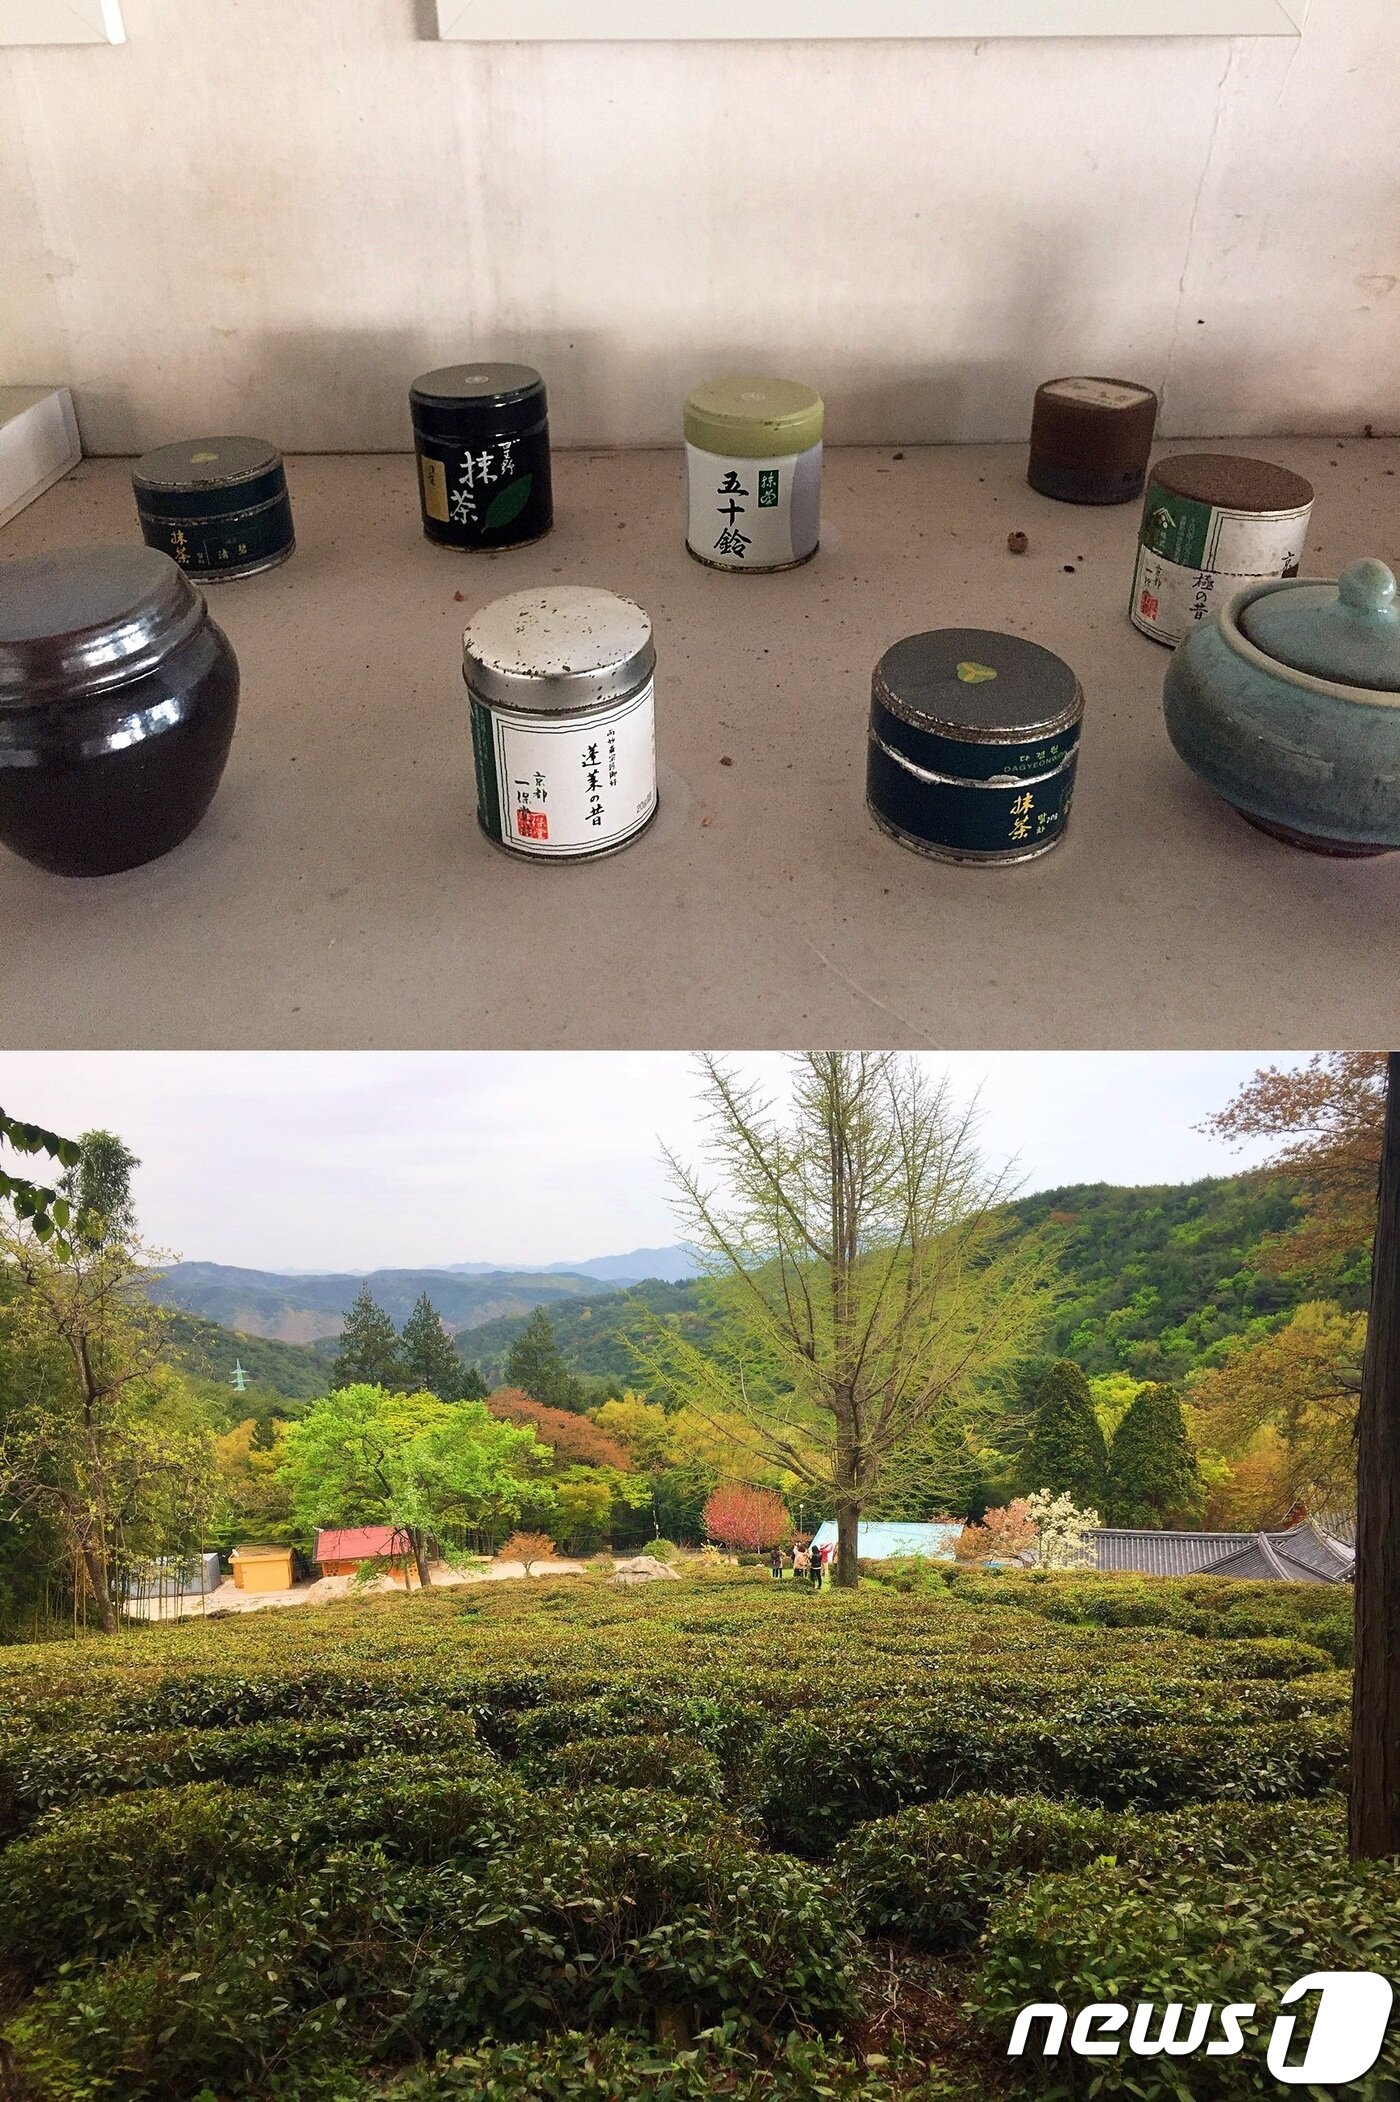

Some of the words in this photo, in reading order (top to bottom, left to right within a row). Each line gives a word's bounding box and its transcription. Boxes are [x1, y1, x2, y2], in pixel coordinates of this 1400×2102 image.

[449, 451, 498, 524] 抹茶
[713, 470, 752, 559] 五十鈴
[170, 529, 191, 564] 抹茶
[1189, 572, 1215, 620] 極の昔
[532, 771, 548, 803] 京都
[1008, 791, 1036, 841] 抹茶
